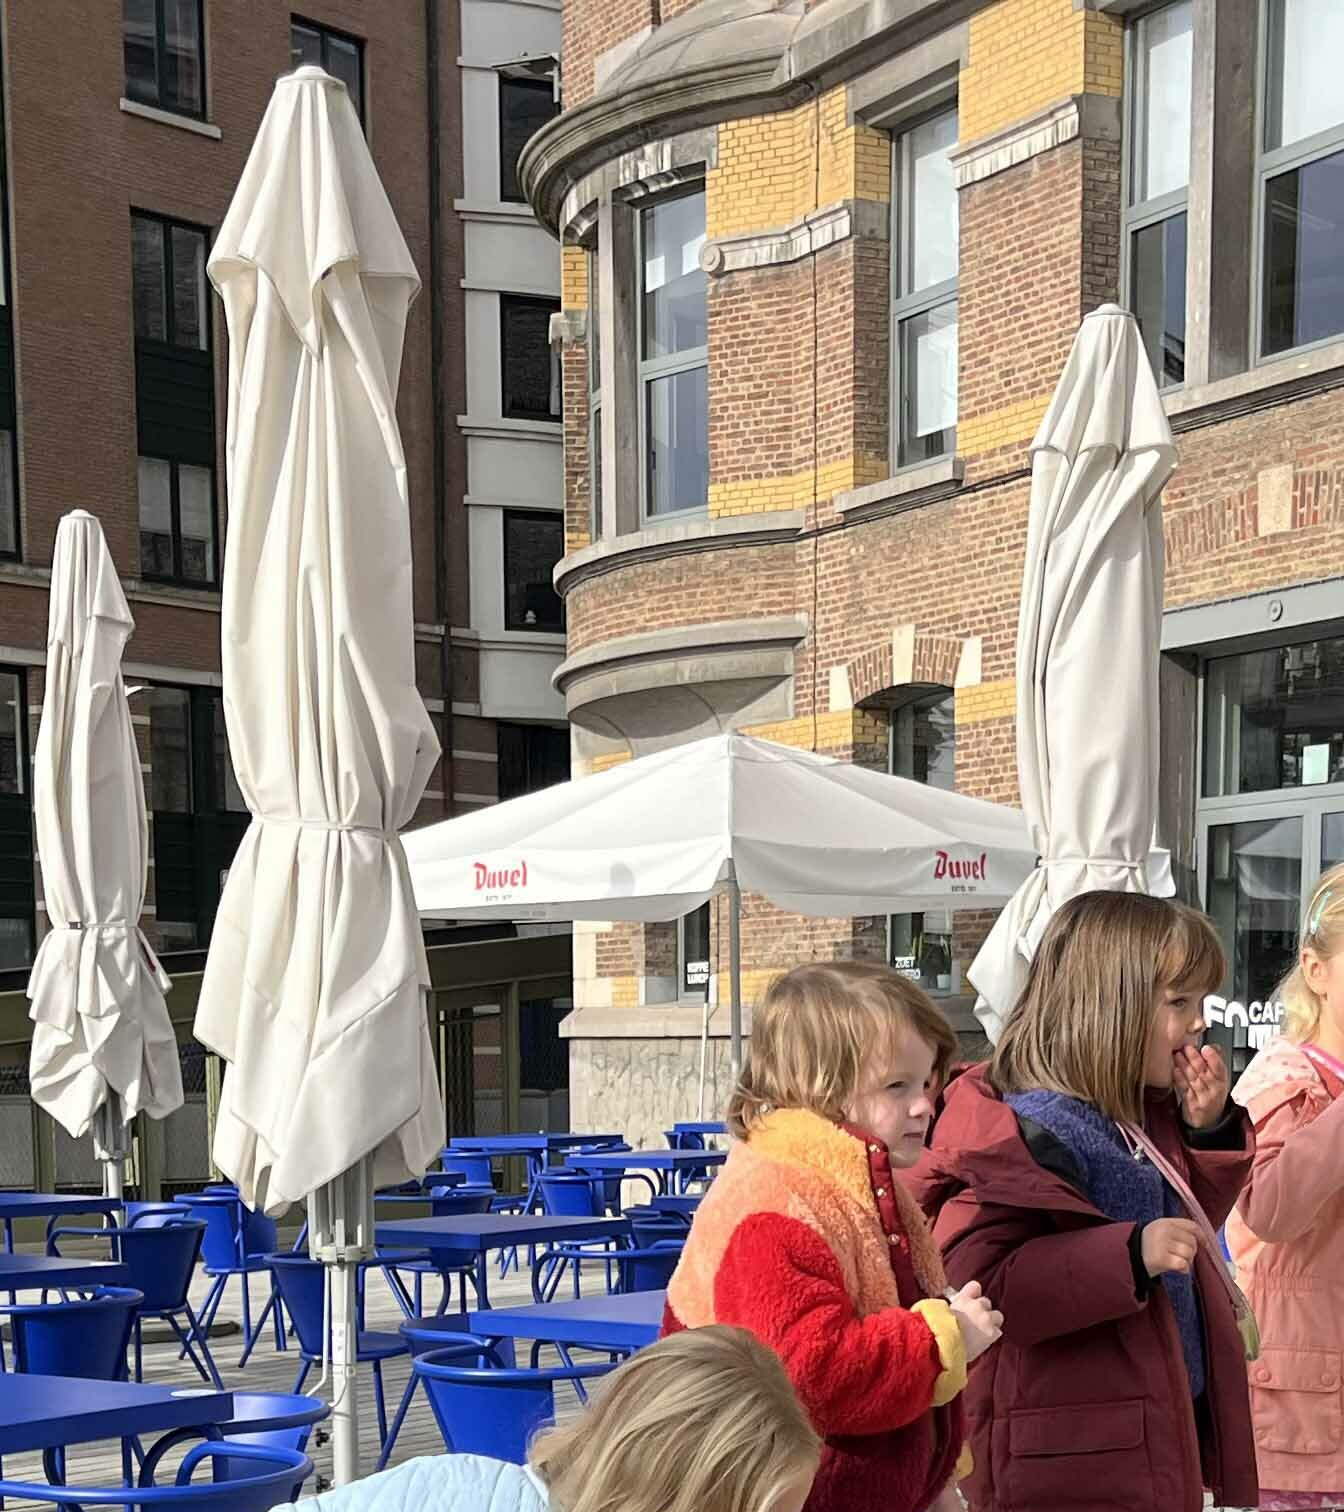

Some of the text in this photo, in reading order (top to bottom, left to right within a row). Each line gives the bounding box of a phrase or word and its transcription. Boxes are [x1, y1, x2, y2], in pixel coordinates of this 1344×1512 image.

[473, 860, 527, 890] Duvel
[934, 850, 986, 880] Duvel
[1249, 1001, 1285, 1024] CAF
